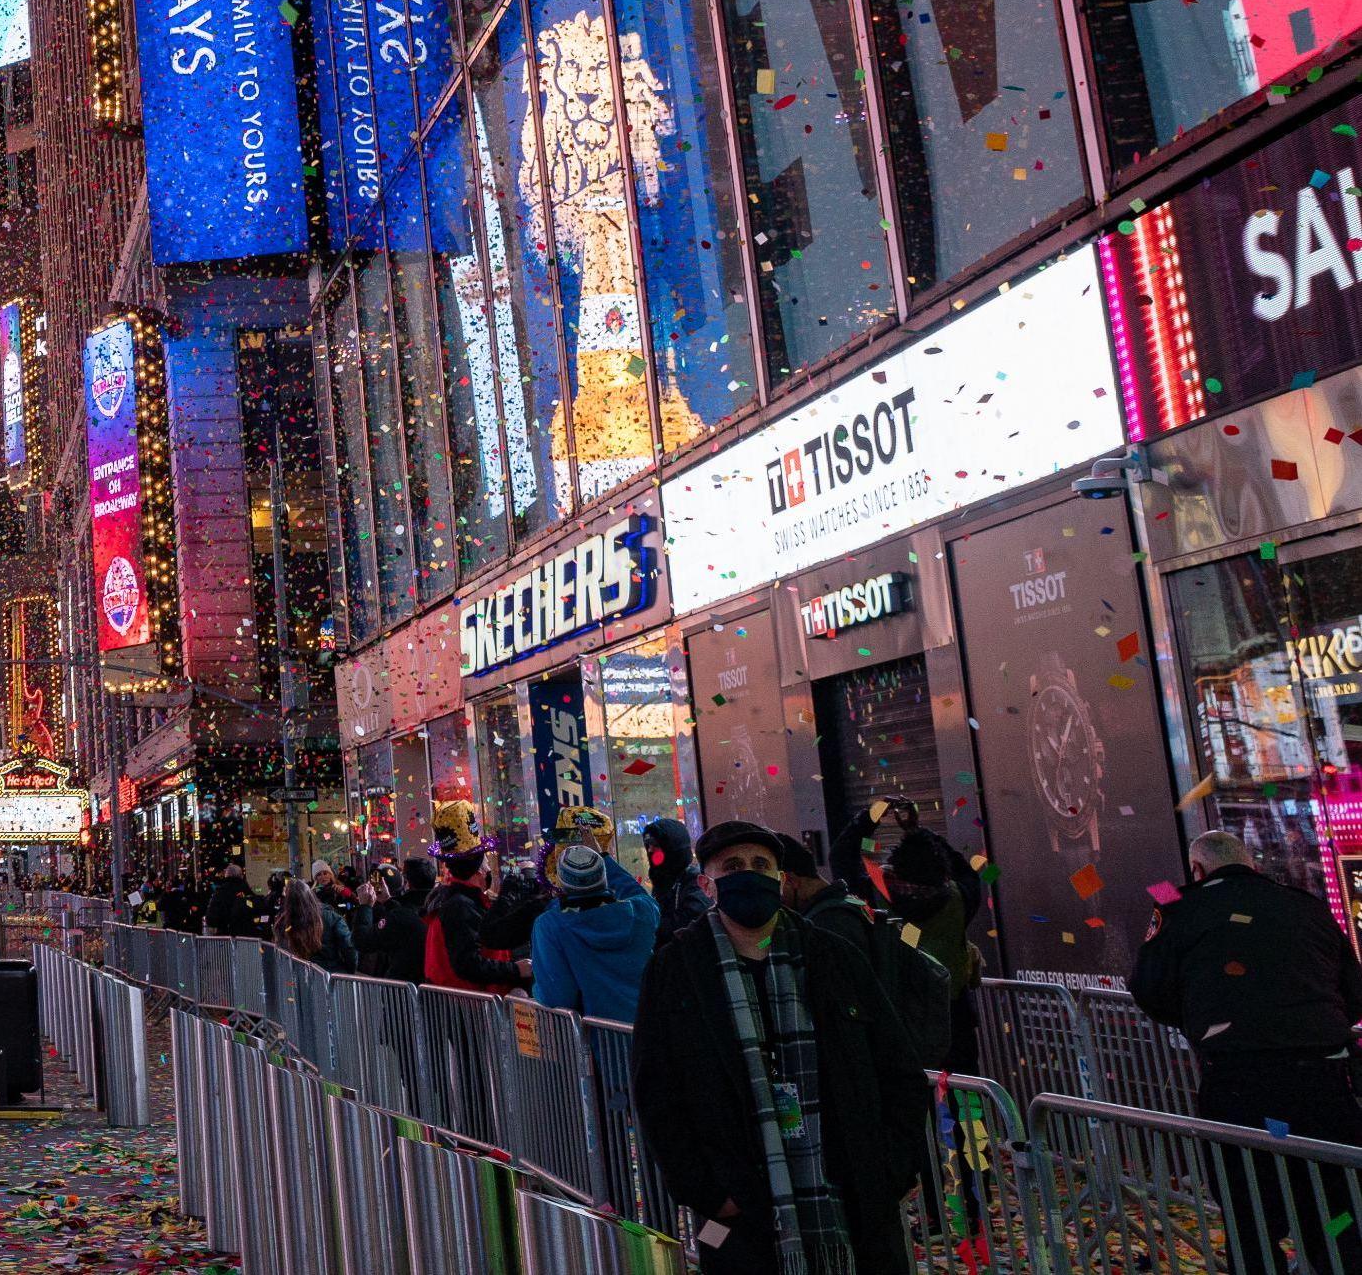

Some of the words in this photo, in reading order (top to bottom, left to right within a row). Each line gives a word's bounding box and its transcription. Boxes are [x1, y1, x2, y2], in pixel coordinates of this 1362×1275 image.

[237, 64, 260, 102] TO
[803, 386, 916, 496] TISSOT
[93, 454, 135, 481] ENTRANCE
[94, 491, 138, 518] BROADWAY
[774, 520, 807, 555] SWISS
[808, 498, 860, 540] WATCHES
[861, 481, 899, 519] SINCE
[902, 468, 930, 502] 1853
[459, 527, 633, 679] SKECHERS
[823, 576, 894, 631] TISSOT
[1008, 571, 1067, 611] TISSOT
[717, 665, 748, 692] TISSOT
[6, 774, 32, 787] Hard
[32, 774, 56, 788] Rock
[1016, 969, 1046, 984] CLOSED
[1047, 970, 1065, 986] FOR
[1065, 972, 1126, 991] RENOVATIONS
